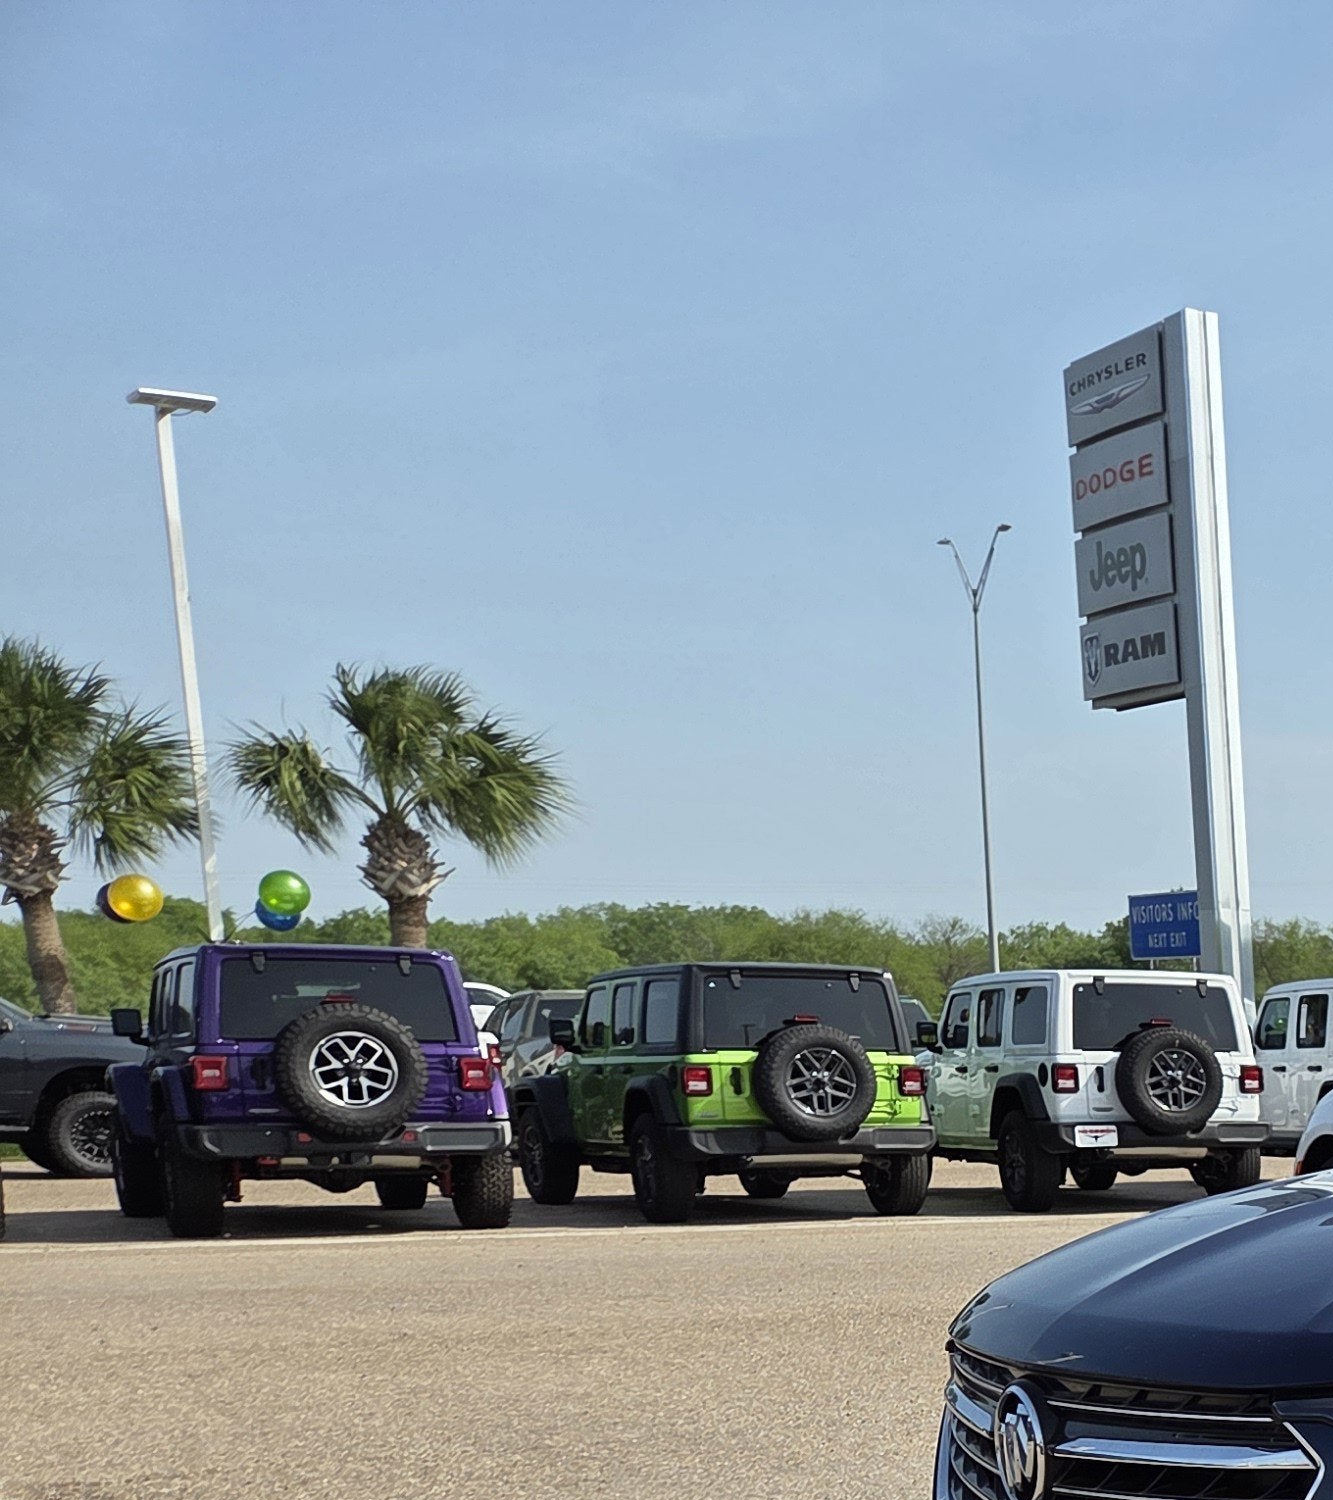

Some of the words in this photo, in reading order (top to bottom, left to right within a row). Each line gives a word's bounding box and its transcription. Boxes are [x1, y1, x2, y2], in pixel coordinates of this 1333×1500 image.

[1069, 352, 1147, 396] CHRYSLER
[1075, 453, 1154, 501] DODGE
[1089, 540, 1147, 592] Jeep
[1103, 631, 1167, 668] RAM
[1131, 903, 1174, 924] VISITORS
[1176, 901, 1199, 921] INFO
[1148, 933, 1167, 948] NEXT
[1170, 931, 1187, 948] EXIT
